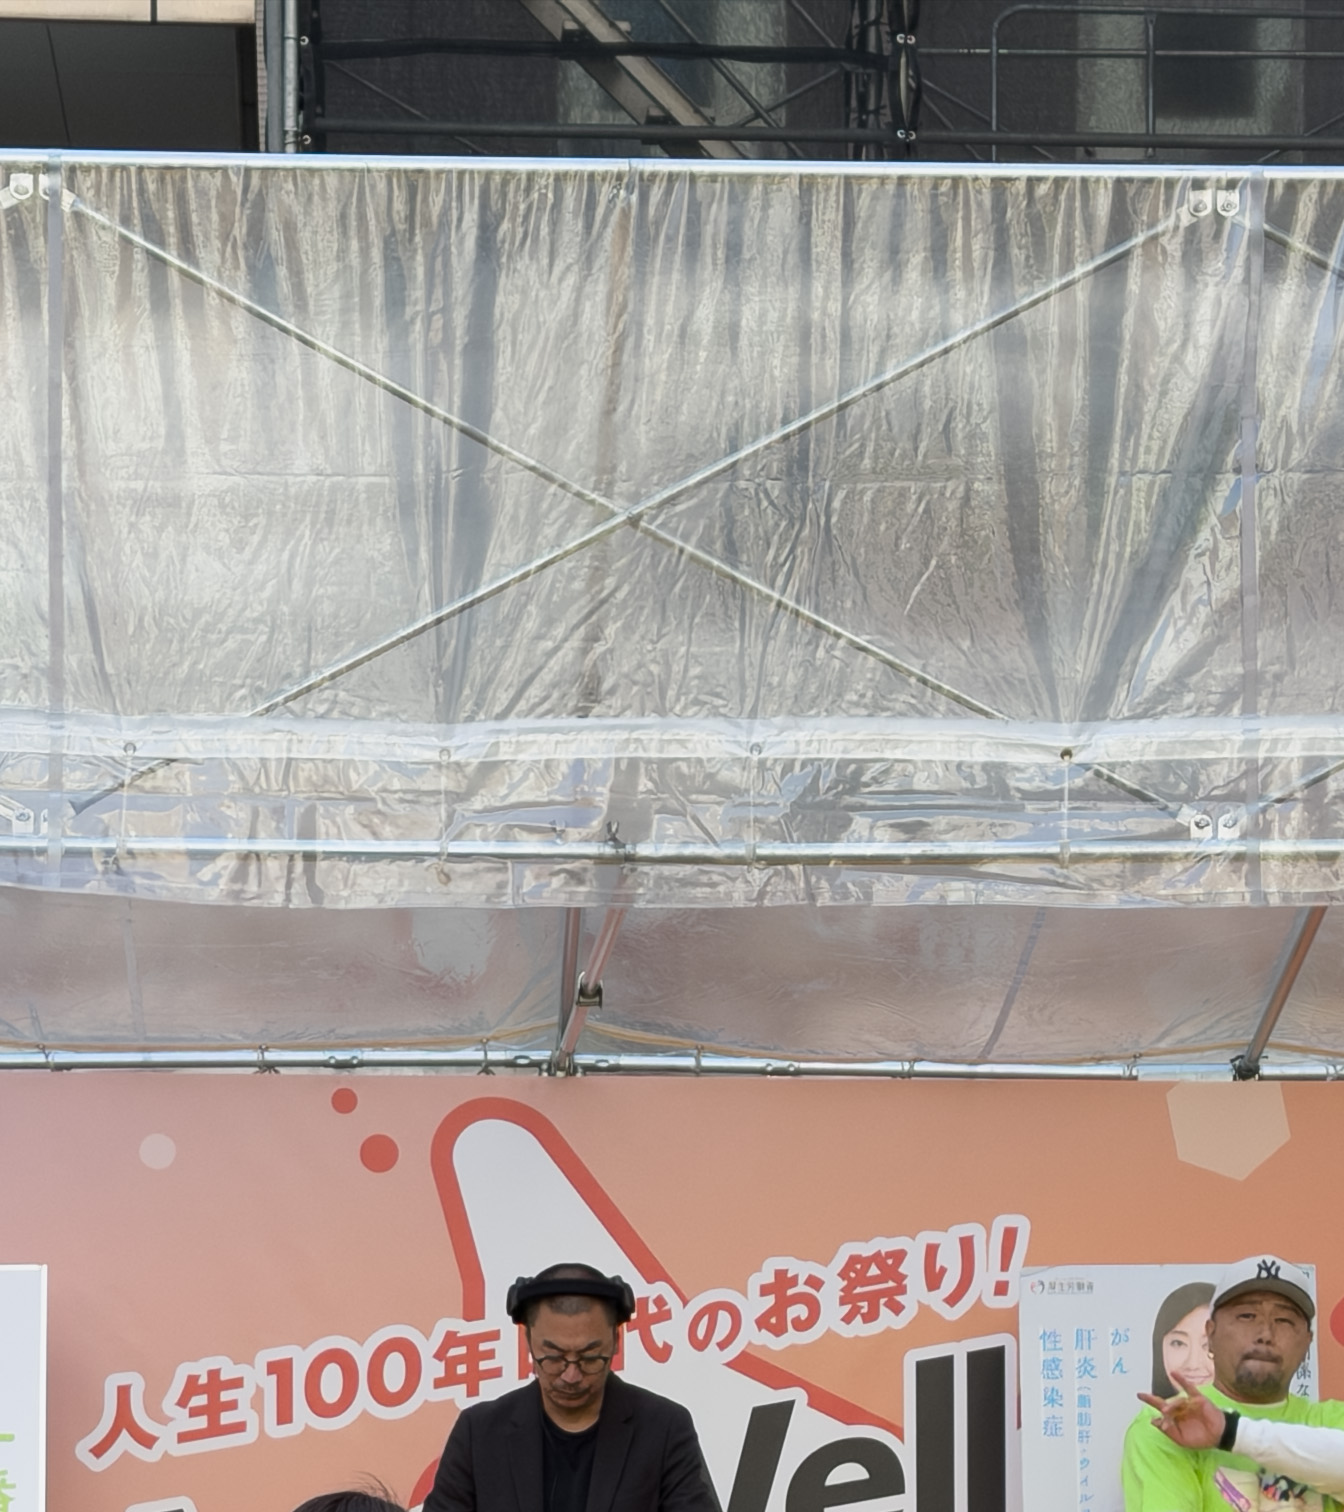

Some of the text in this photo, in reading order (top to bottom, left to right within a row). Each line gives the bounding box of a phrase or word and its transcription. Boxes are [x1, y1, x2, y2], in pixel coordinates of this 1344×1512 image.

[89, 1226, 1020, 1460] 人生100年代のお祭り!
[1039, 1328, 1064, 1437] 性感染症
[1110, 1328, 1131, 1374] がん
